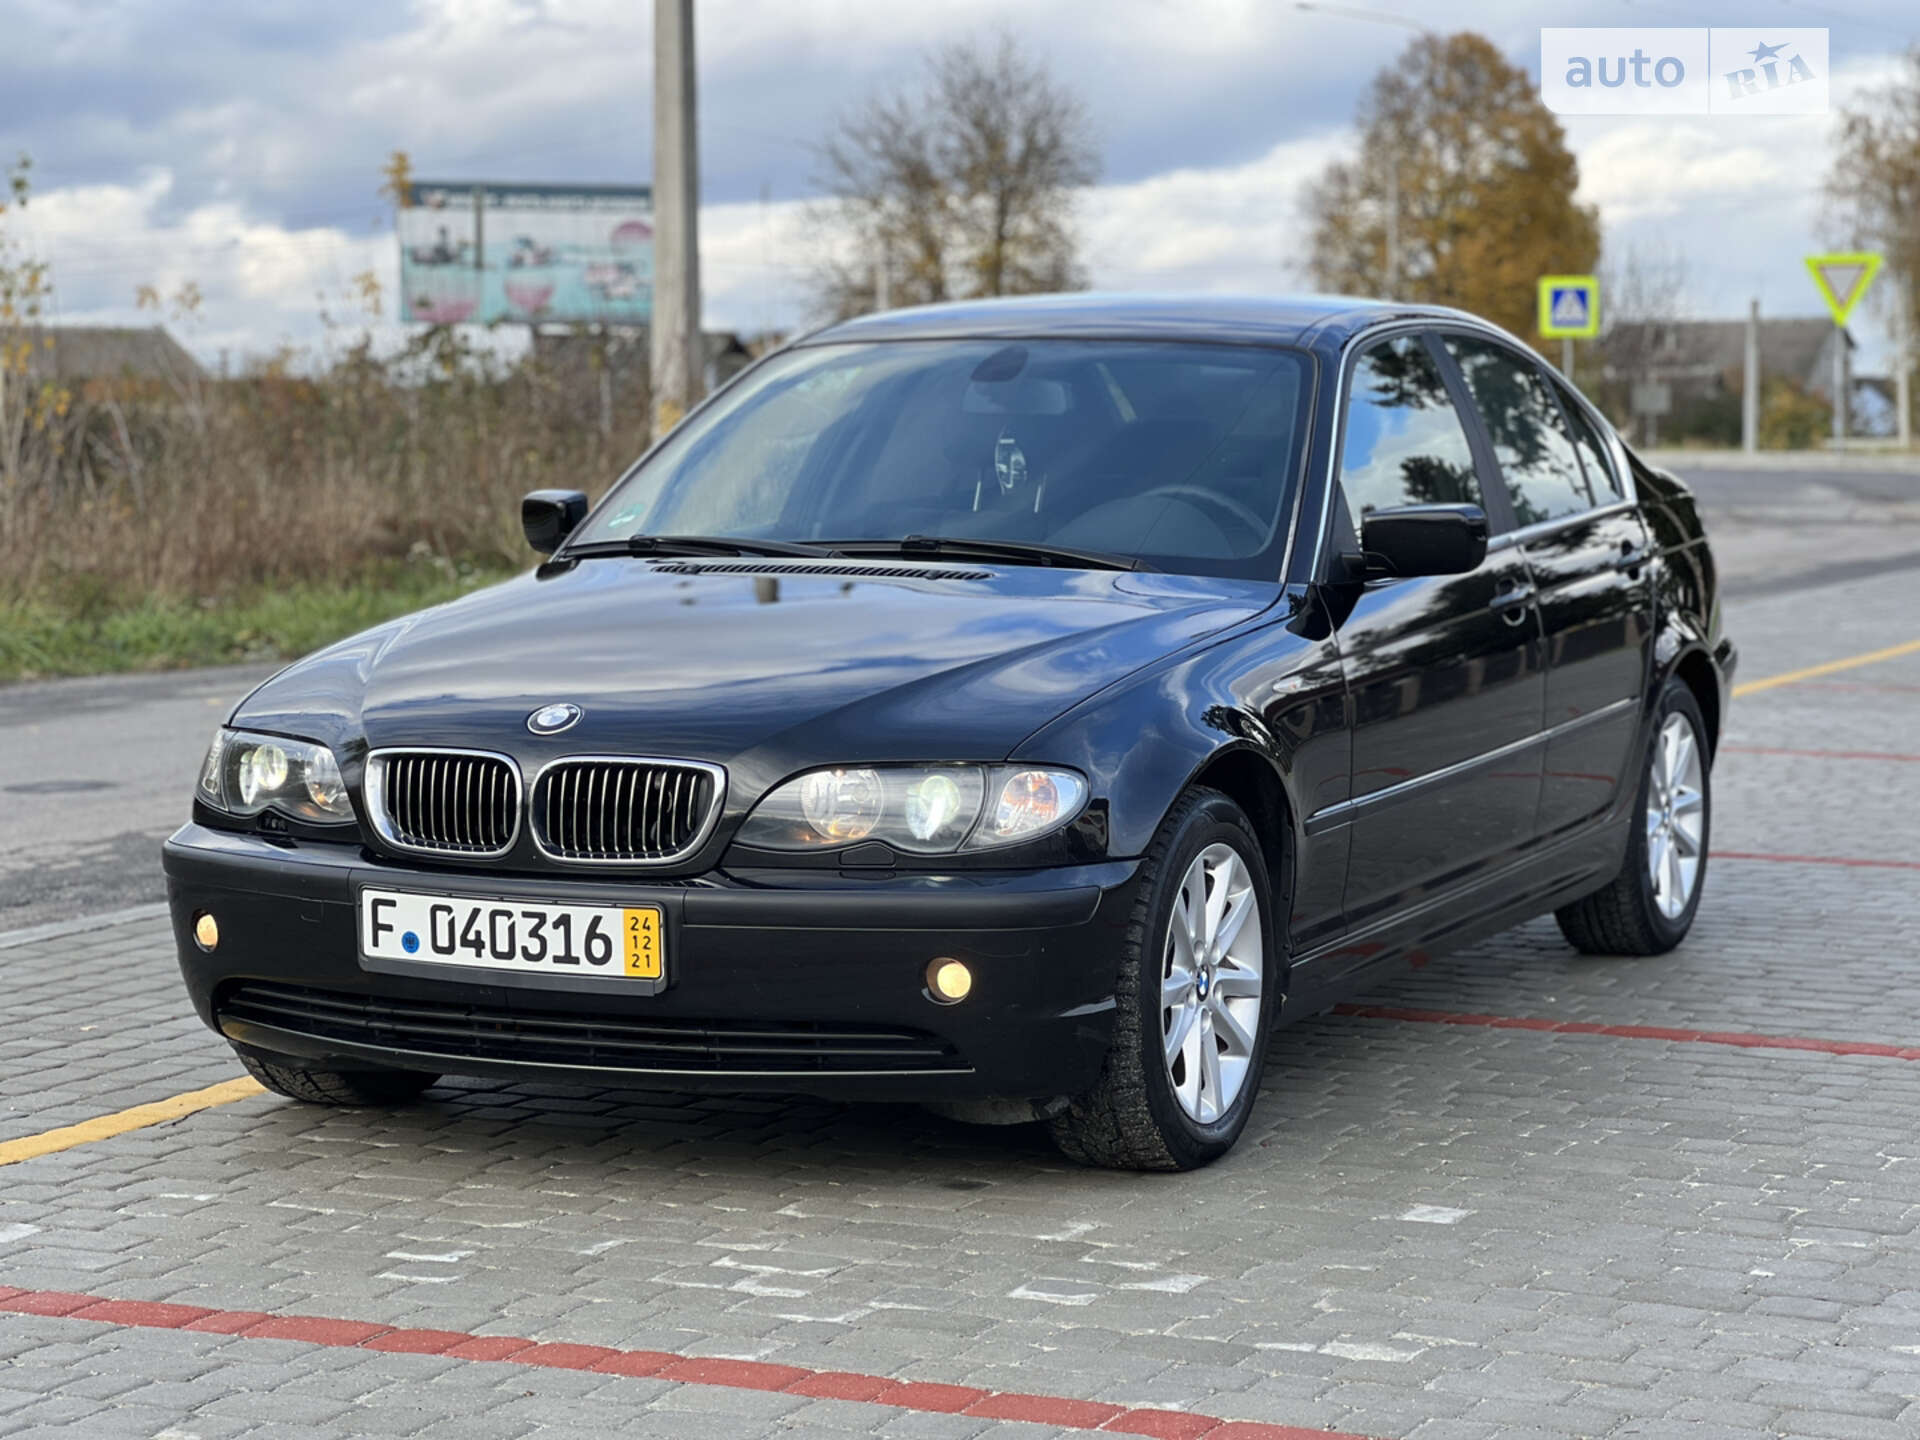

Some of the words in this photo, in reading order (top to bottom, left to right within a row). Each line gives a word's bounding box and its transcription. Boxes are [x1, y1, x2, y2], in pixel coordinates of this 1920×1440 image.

[371, 898, 397, 948] F
[430, 904, 613, 966] 040316
[630, 916, 652, 932] 24
[632, 935, 652, 950] 12
[631, 953, 652, 969] 21
